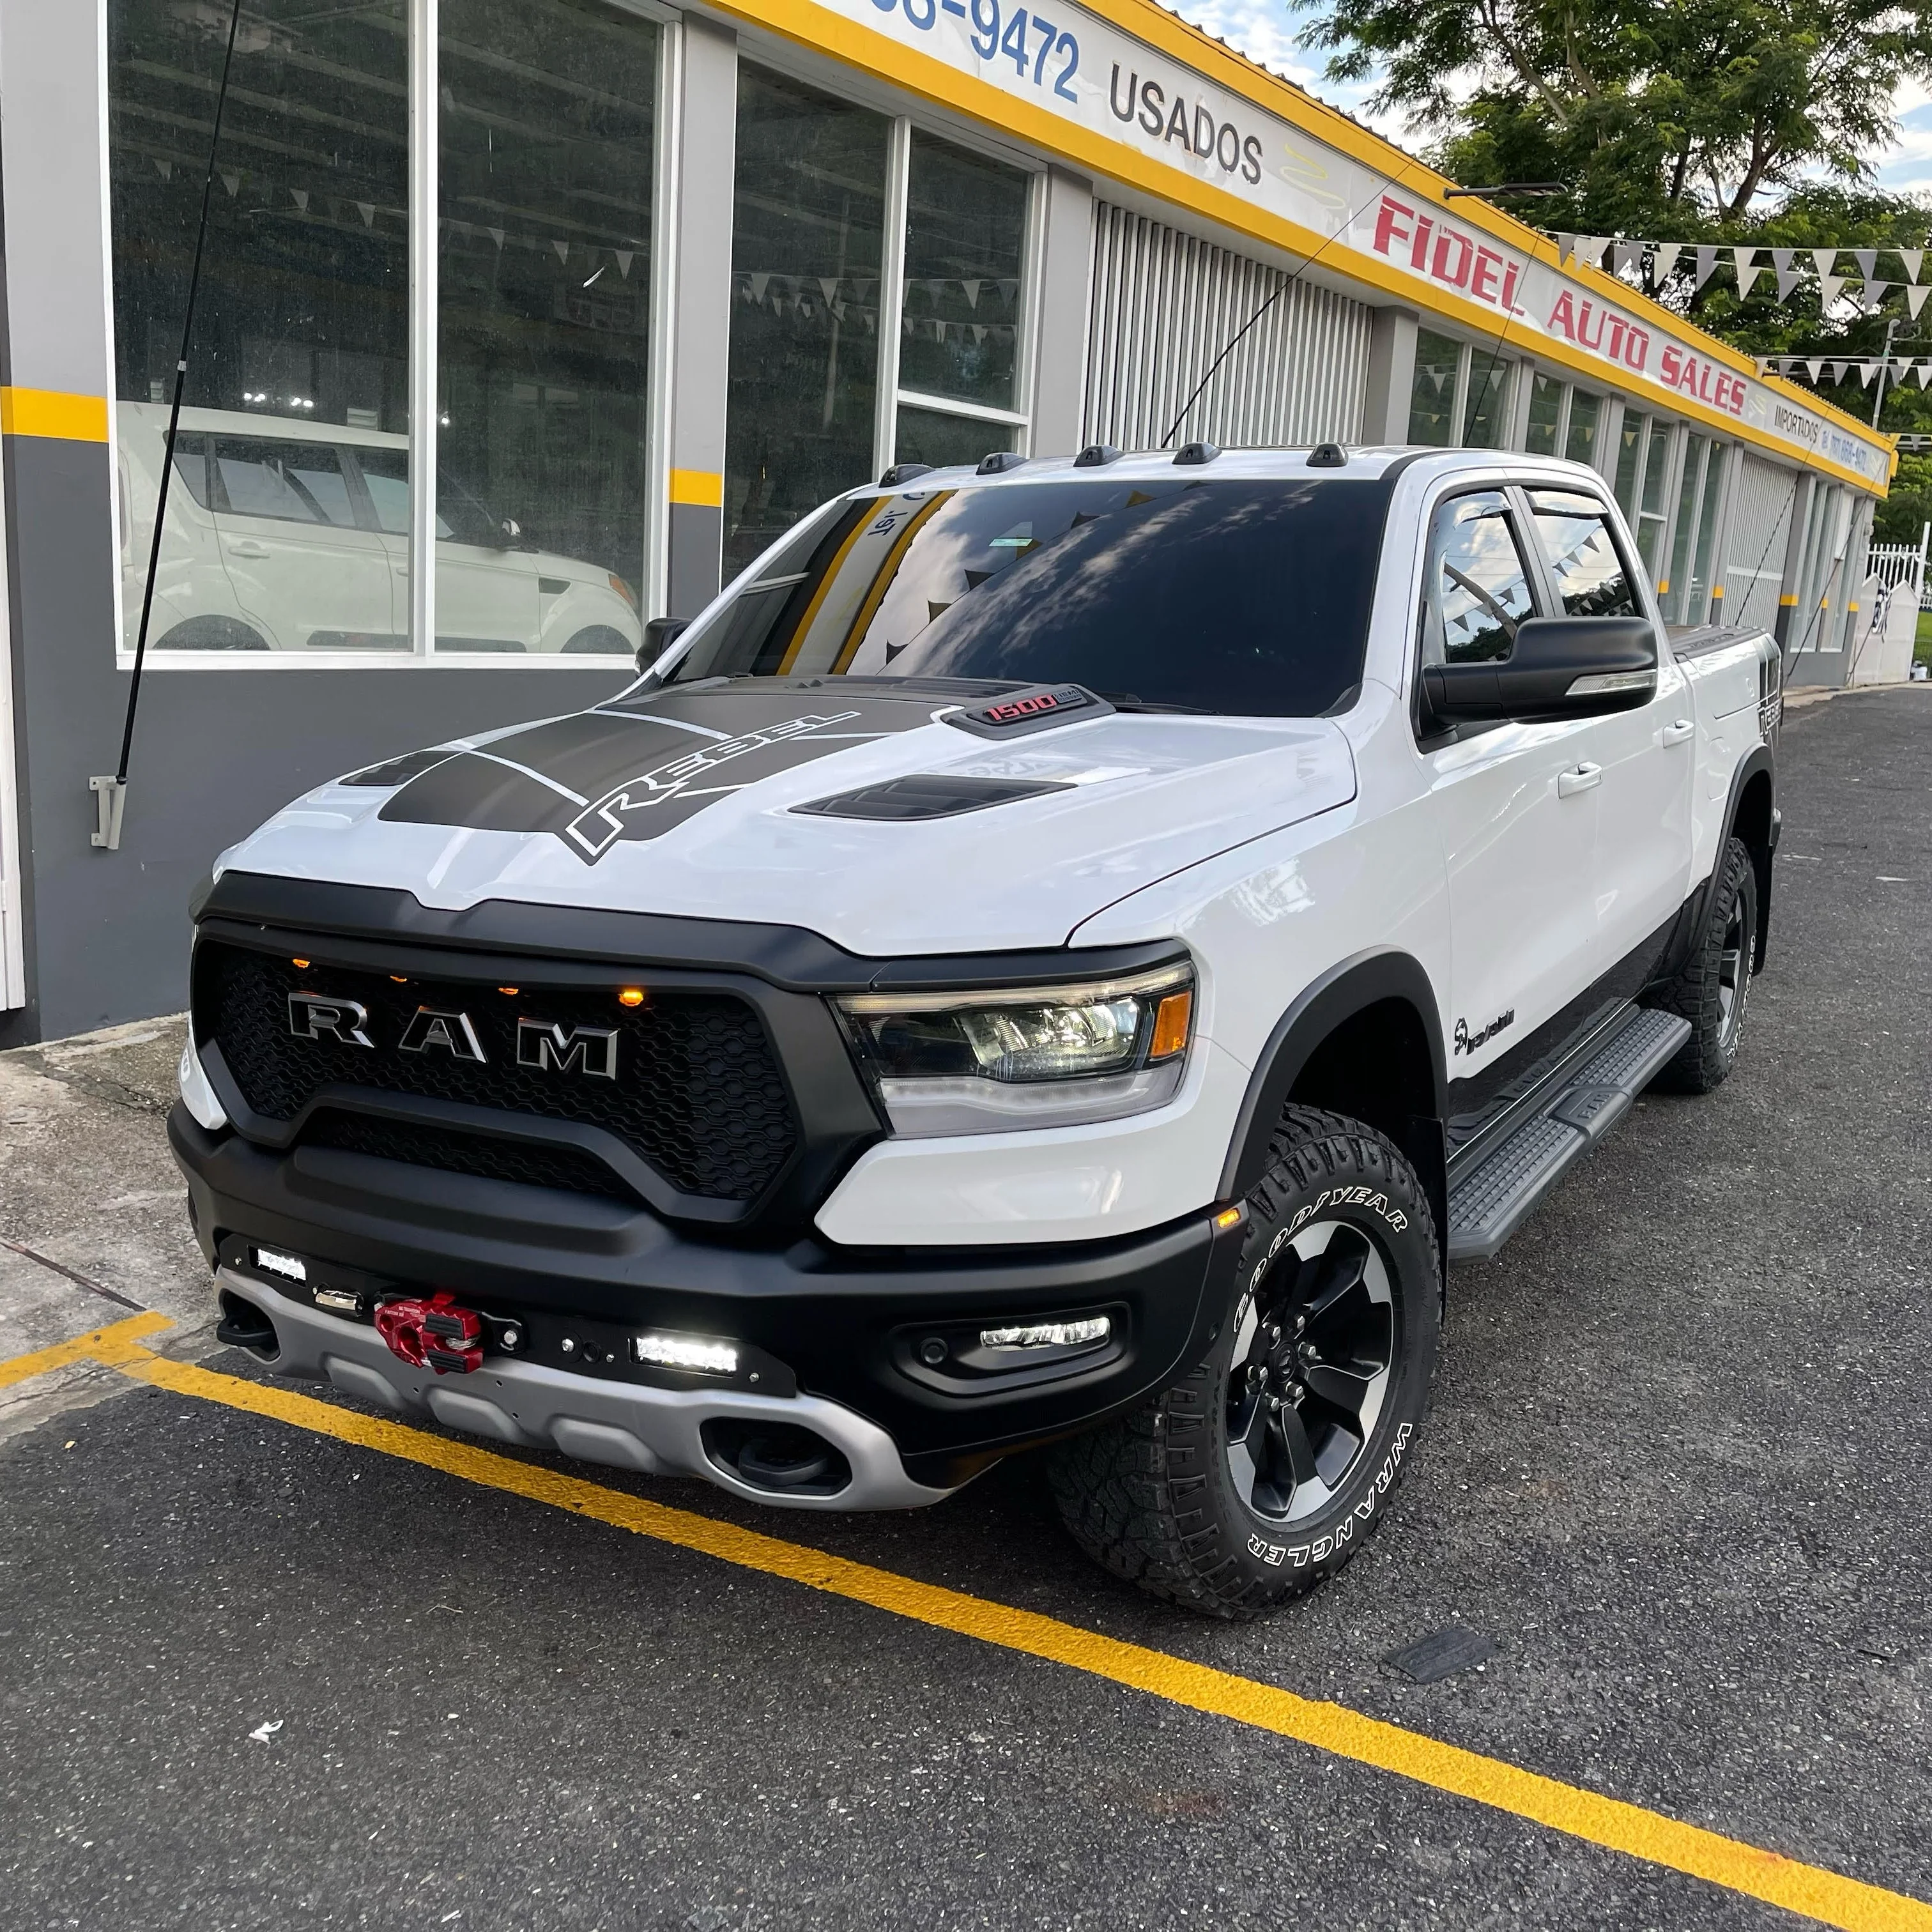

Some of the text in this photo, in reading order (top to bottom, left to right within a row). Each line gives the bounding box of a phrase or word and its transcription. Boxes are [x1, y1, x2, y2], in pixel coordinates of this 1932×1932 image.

[1110, 63, 1264, 185] USADOS
[1373, 194, 1525, 316] FIDEL
[1547, 289, 1649, 371] AUTO
[1660, 345, 1747, 416] SALES
[987, 694, 1057, 721] 1500
[565, 711, 861, 857] REBEL
[288, 992, 620, 1081] RAM
[1233, 1186, 1408, 1333] GOODYEAR
[1247, 1422, 1413, 1567] WRANGLER
